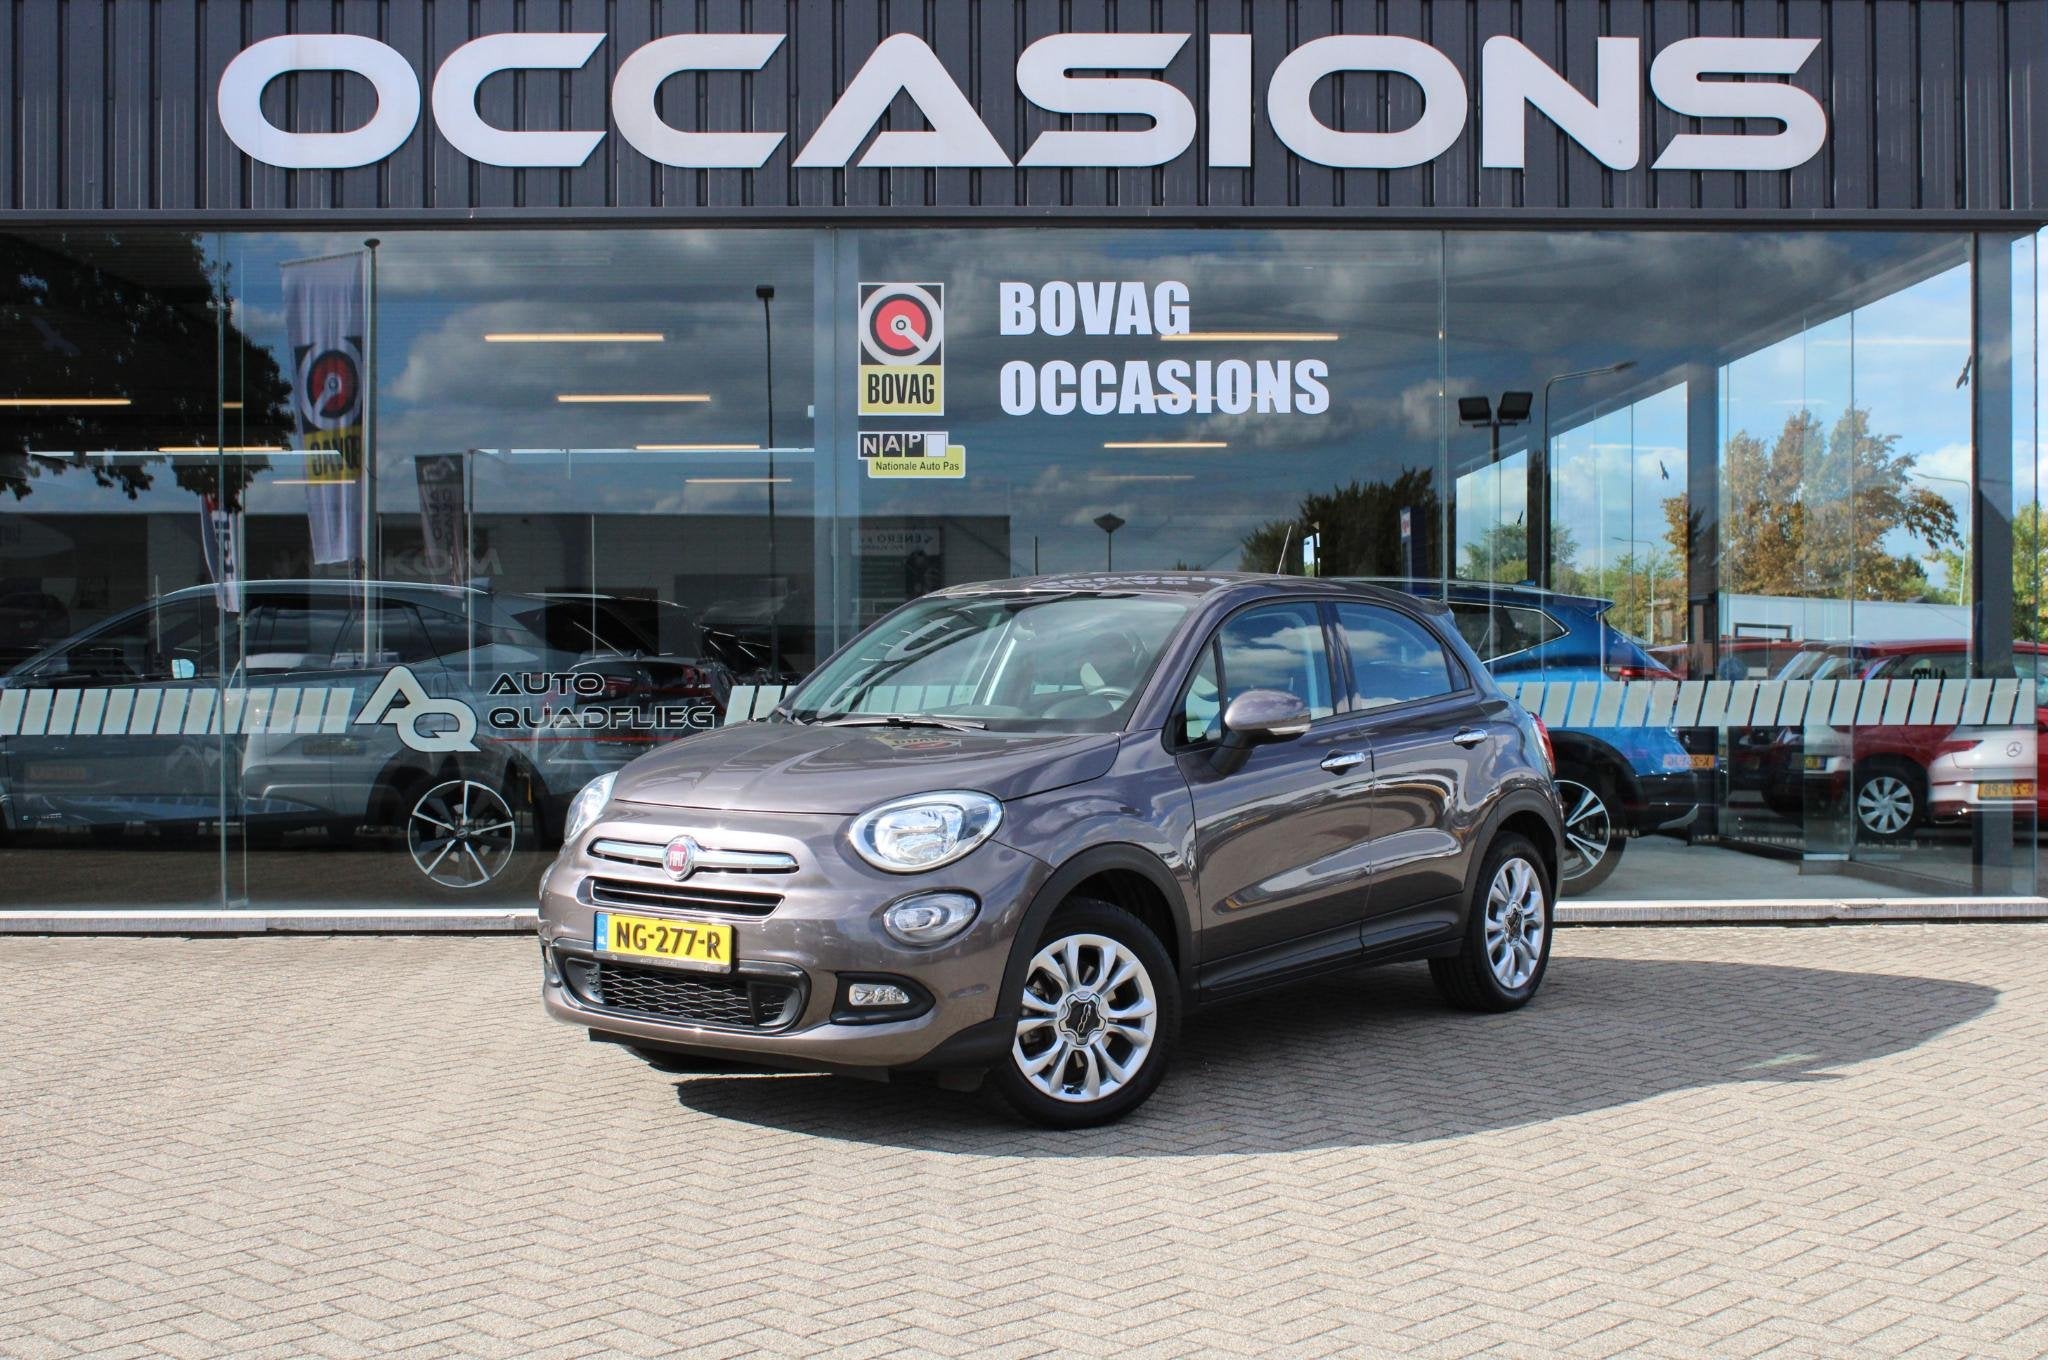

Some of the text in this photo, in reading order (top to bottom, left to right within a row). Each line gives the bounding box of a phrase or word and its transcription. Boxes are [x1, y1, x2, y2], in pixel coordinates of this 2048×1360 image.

[217, 32, 1827, 171] OCCASIONS
[1000, 281, 1191, 336] BOVAG
[867, 373, 935, 406] BOVAG
[1000, 359, 1330, 416] OCCASIONS
[875, 461, 960, 471] Nationale Auto Pas
[487, 672, 605, 696] AUTO
[487, 706, 715, 730] QUADFLIEG
[669, 851, 685, 867] FIAT
[616, 921, 721, 960] NG-277-R
